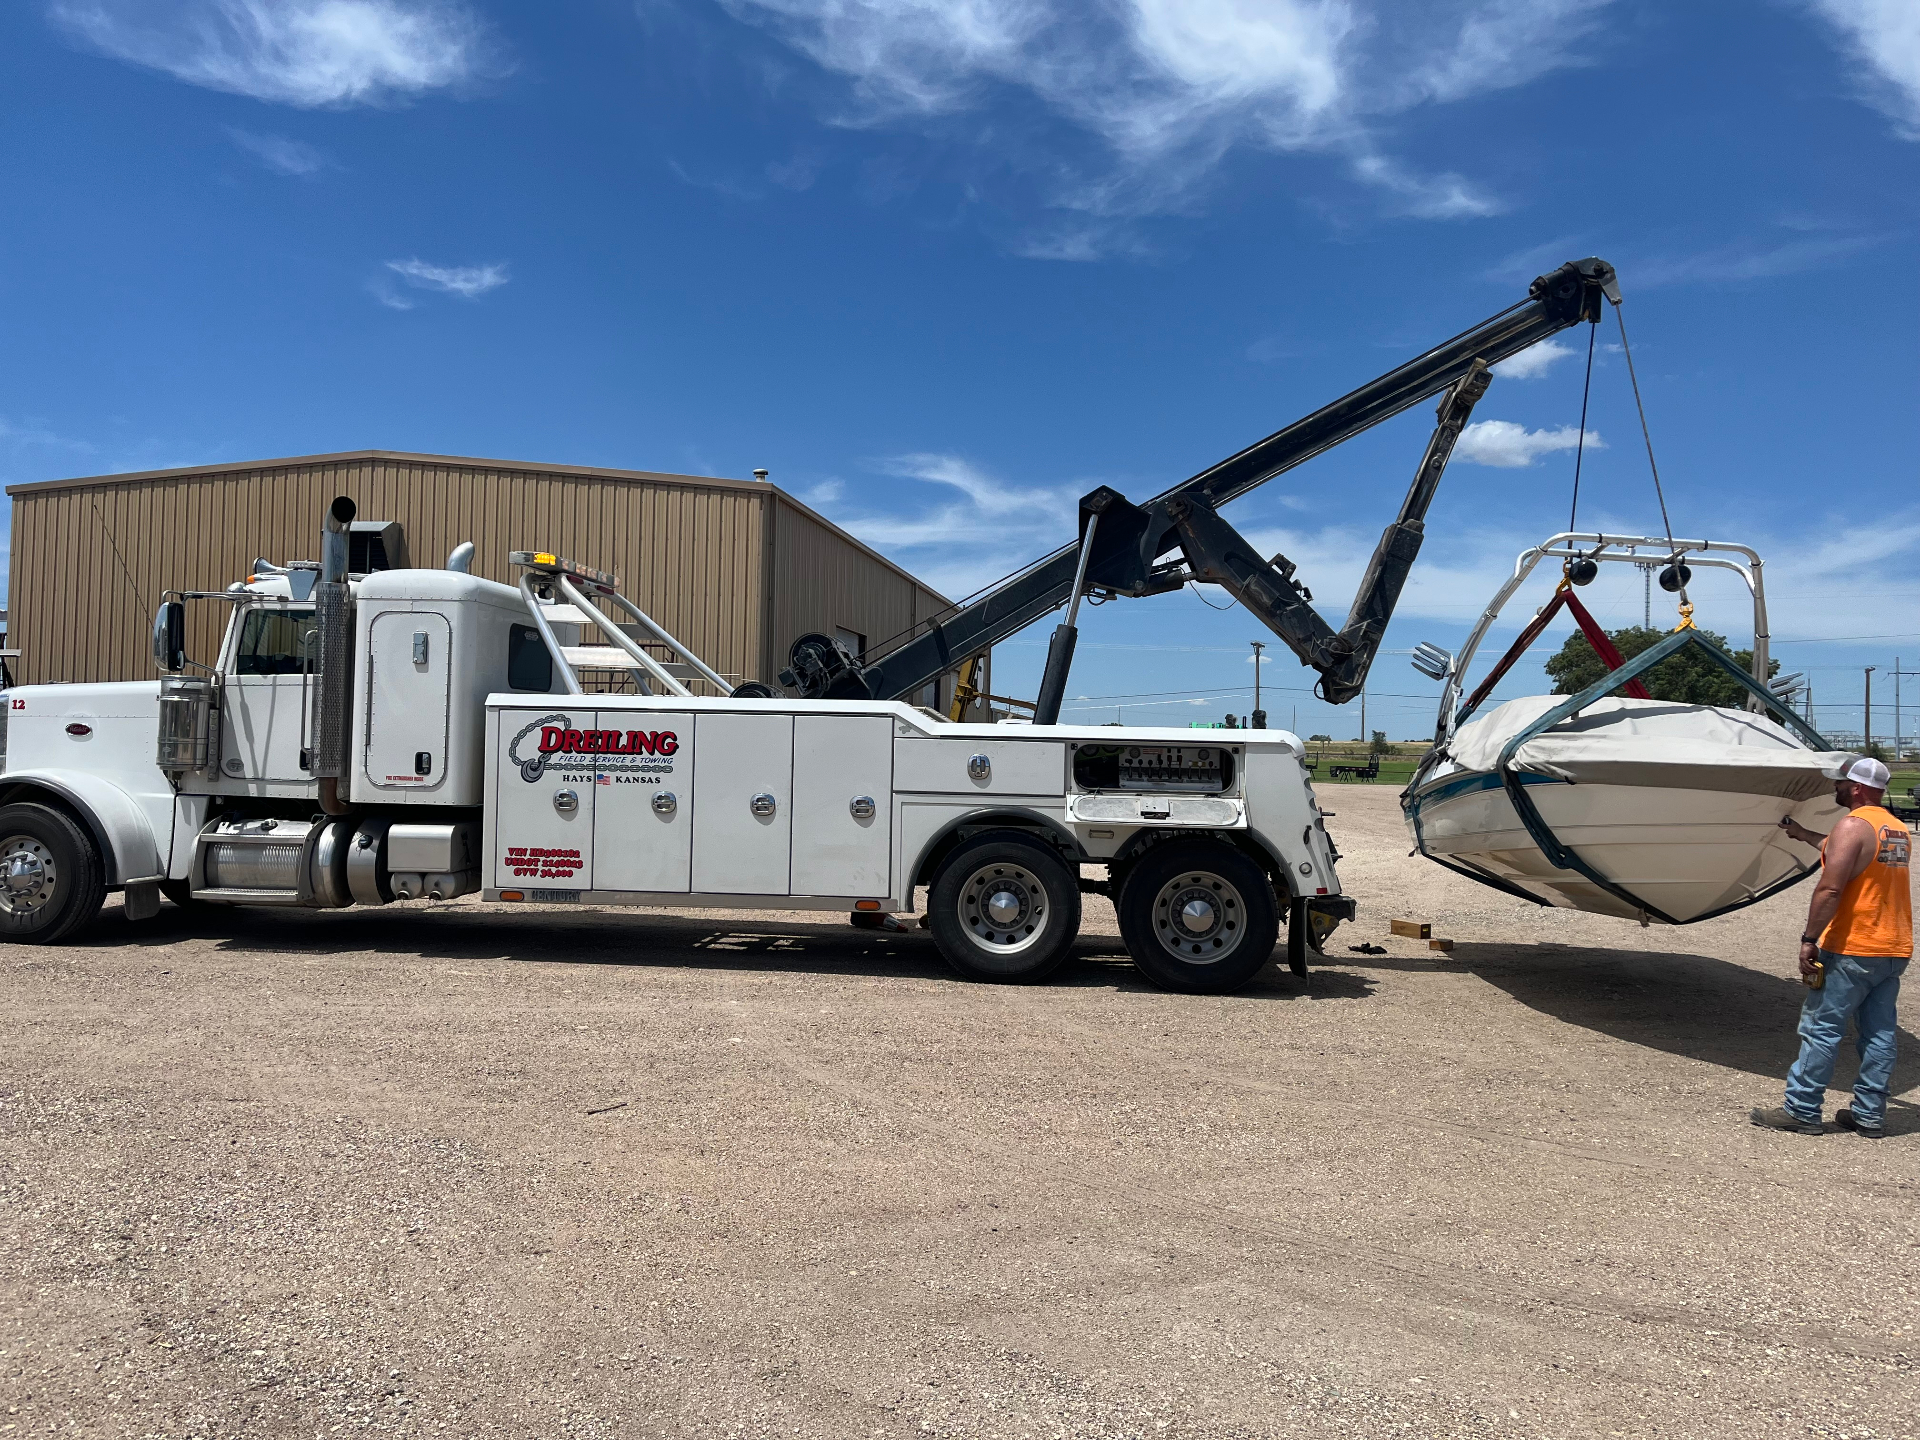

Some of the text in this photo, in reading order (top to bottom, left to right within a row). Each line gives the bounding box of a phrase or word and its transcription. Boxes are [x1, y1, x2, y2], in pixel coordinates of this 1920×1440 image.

[12, 699, 25, 710] 12
[538, 726, 679, 755] DREILING
[558, 755, 674, 765] FIELD SERVICE & TOWING
[562, 774, 661, 784] HAYS KANSAS
[507, 847, 528, 857] VIN
[504, 856, 540, 867] USDOT
[513, 867, 573, 879] GVW 36,000
